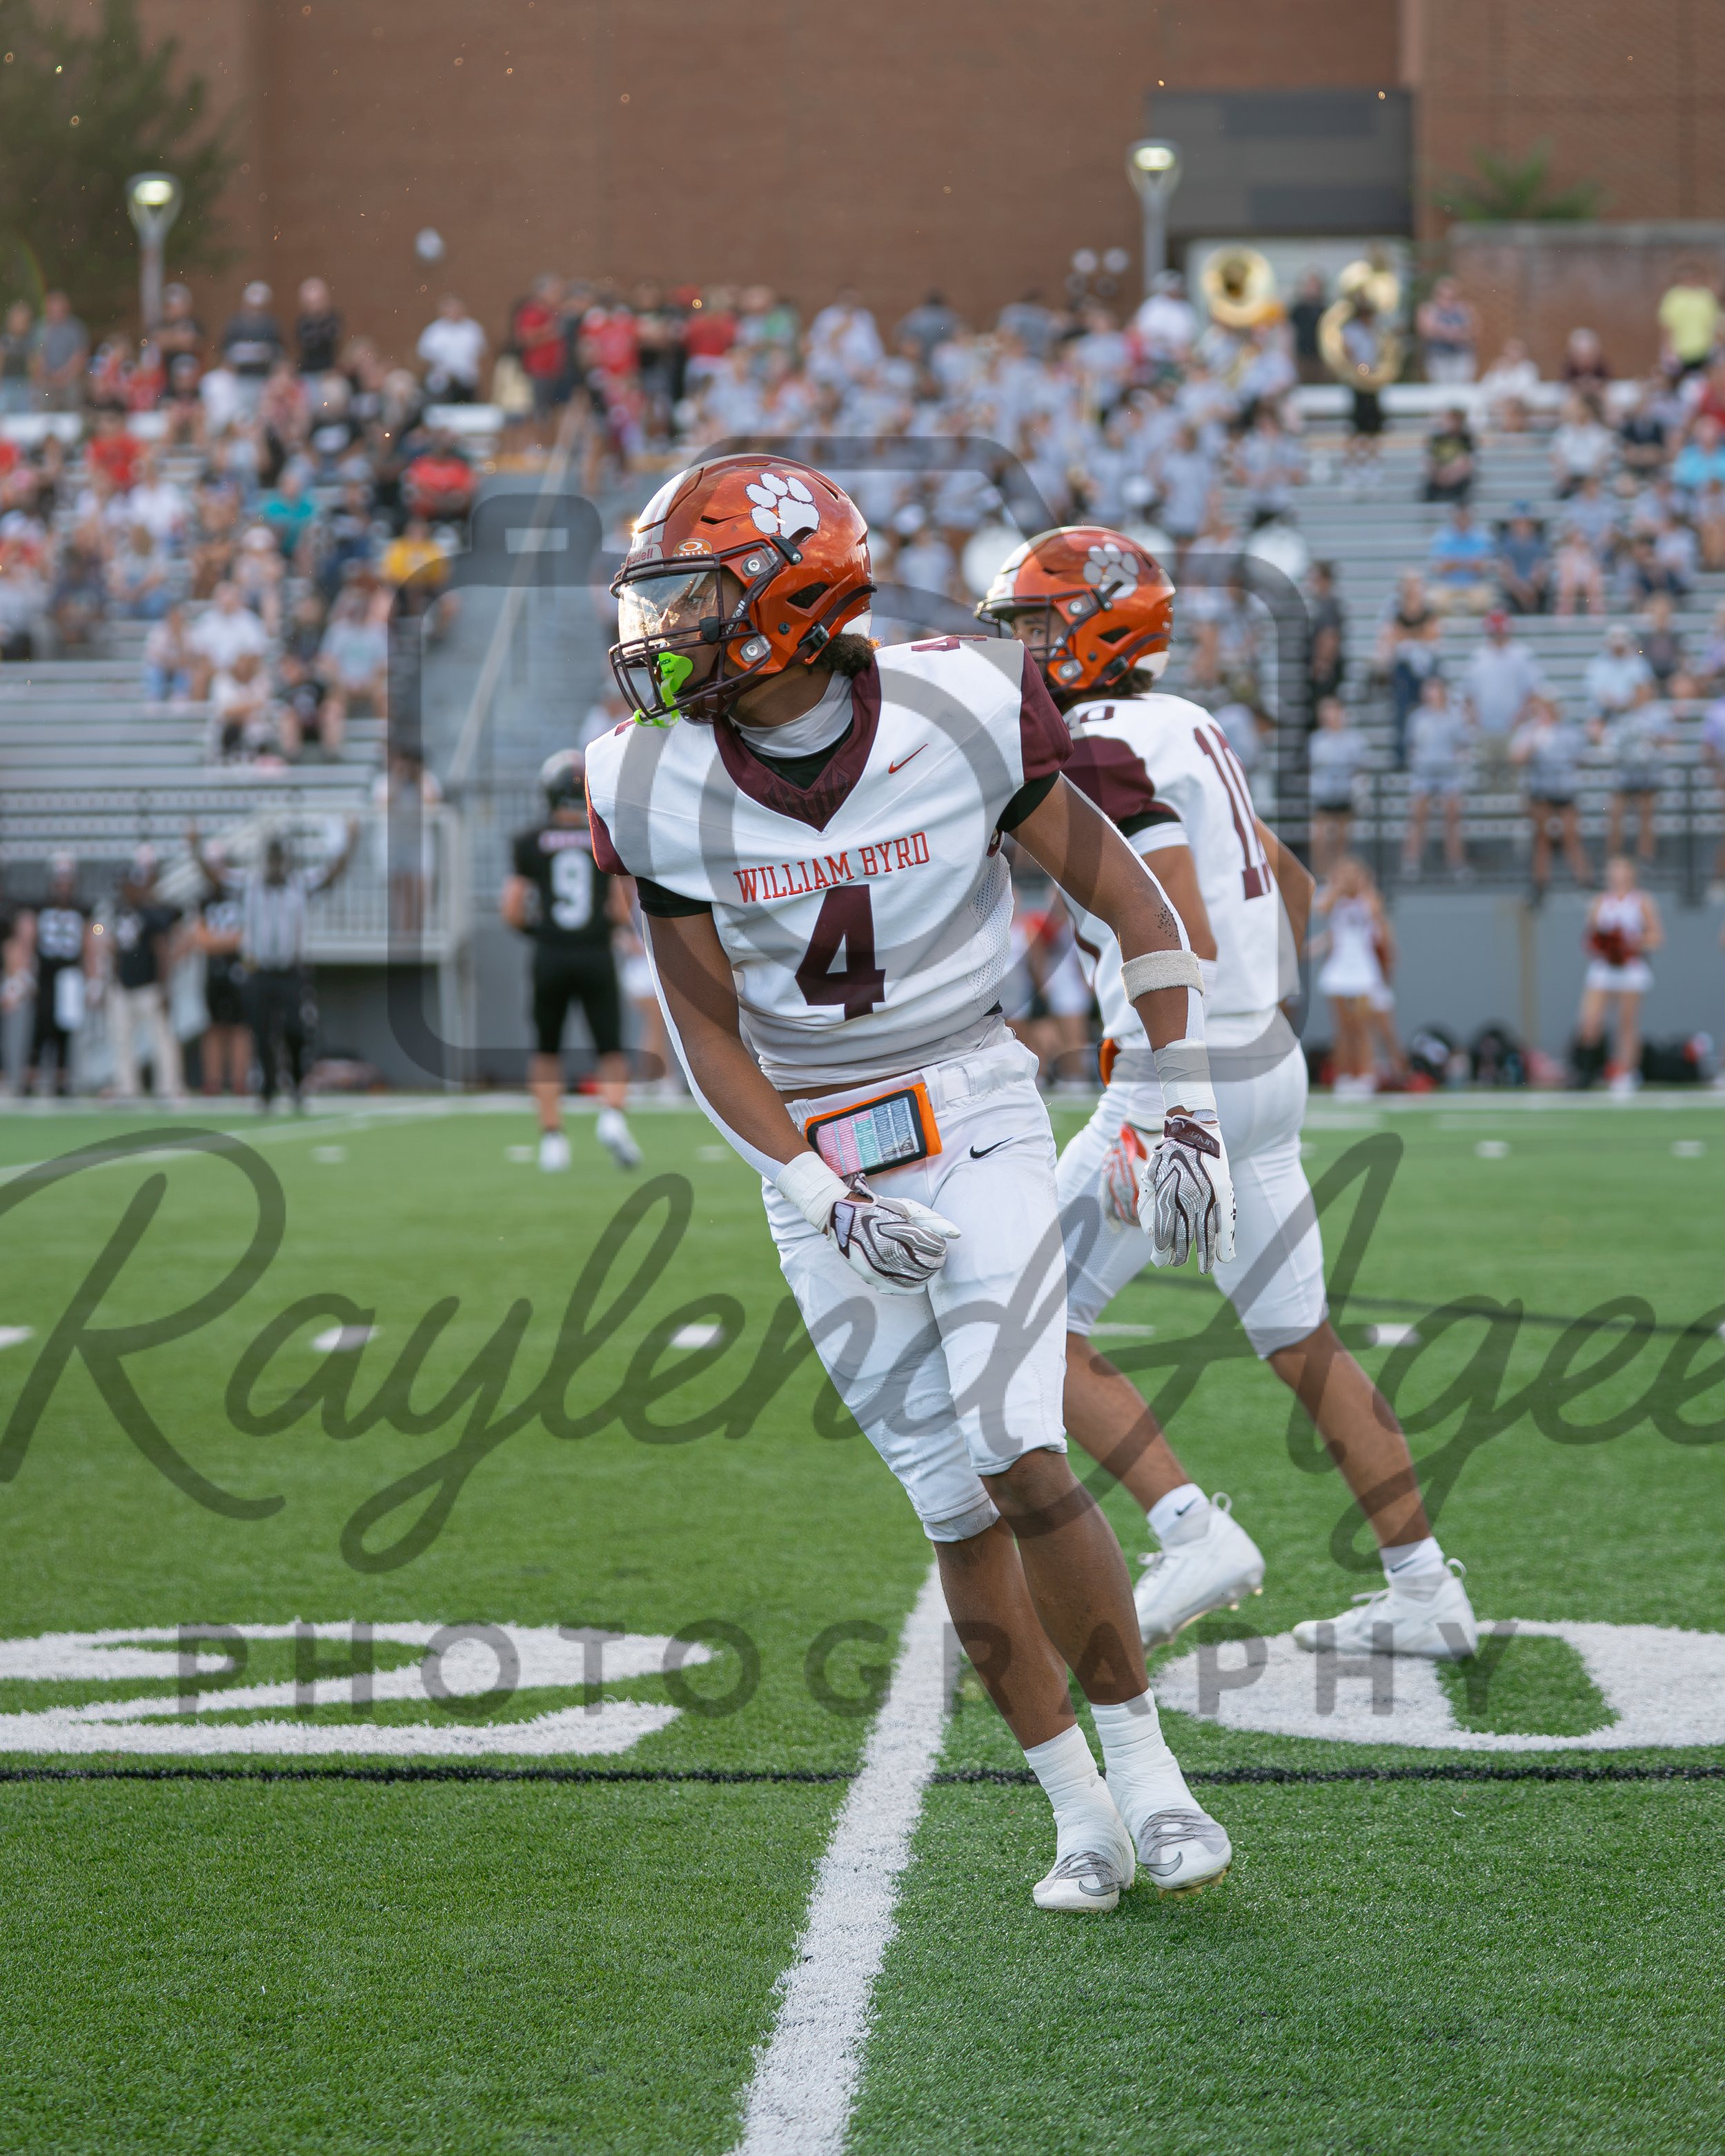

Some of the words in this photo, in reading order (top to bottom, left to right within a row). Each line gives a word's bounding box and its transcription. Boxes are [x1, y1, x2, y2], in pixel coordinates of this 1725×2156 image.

[550, 849, 594, 931] 9
[733, 851, 855, 904] WILLIAM
[858, 831, 930, 876] BYRD
[794, 884, 887, 1022] 4
